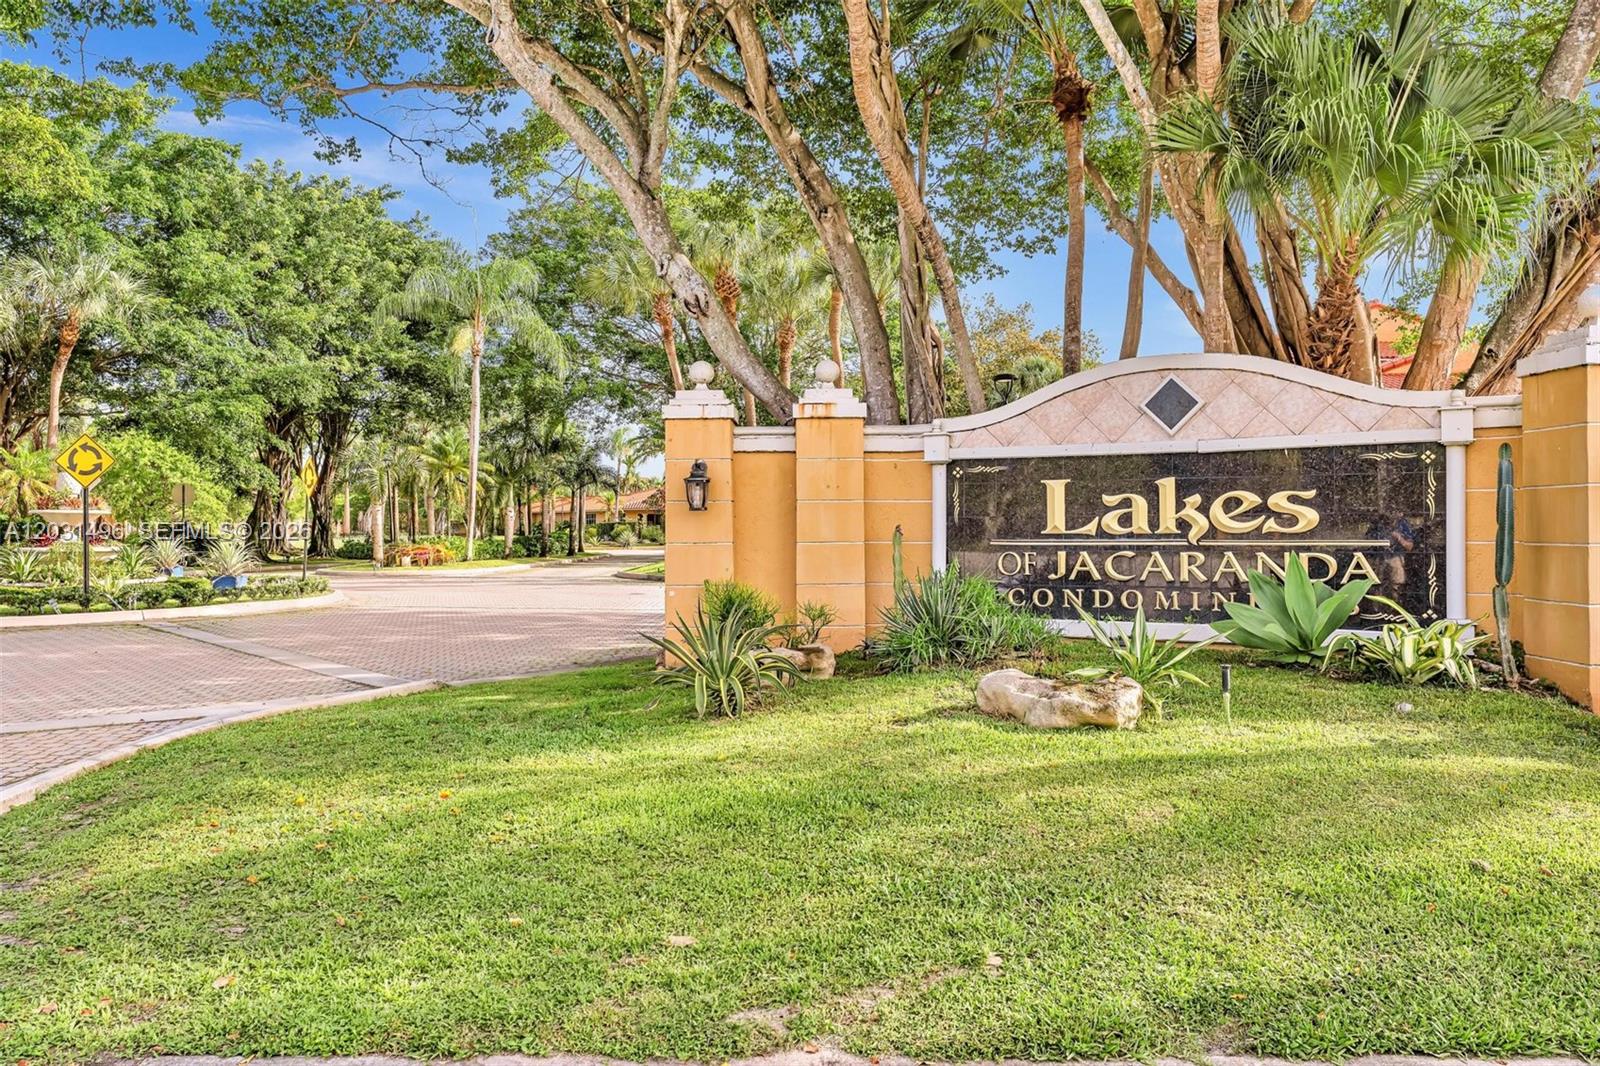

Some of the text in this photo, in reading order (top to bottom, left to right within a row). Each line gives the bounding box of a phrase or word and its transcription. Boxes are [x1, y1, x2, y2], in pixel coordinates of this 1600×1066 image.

[1040, 476, 1321, 545] Lakes
[997, 550, 1381, 585] OF JACARANDA
